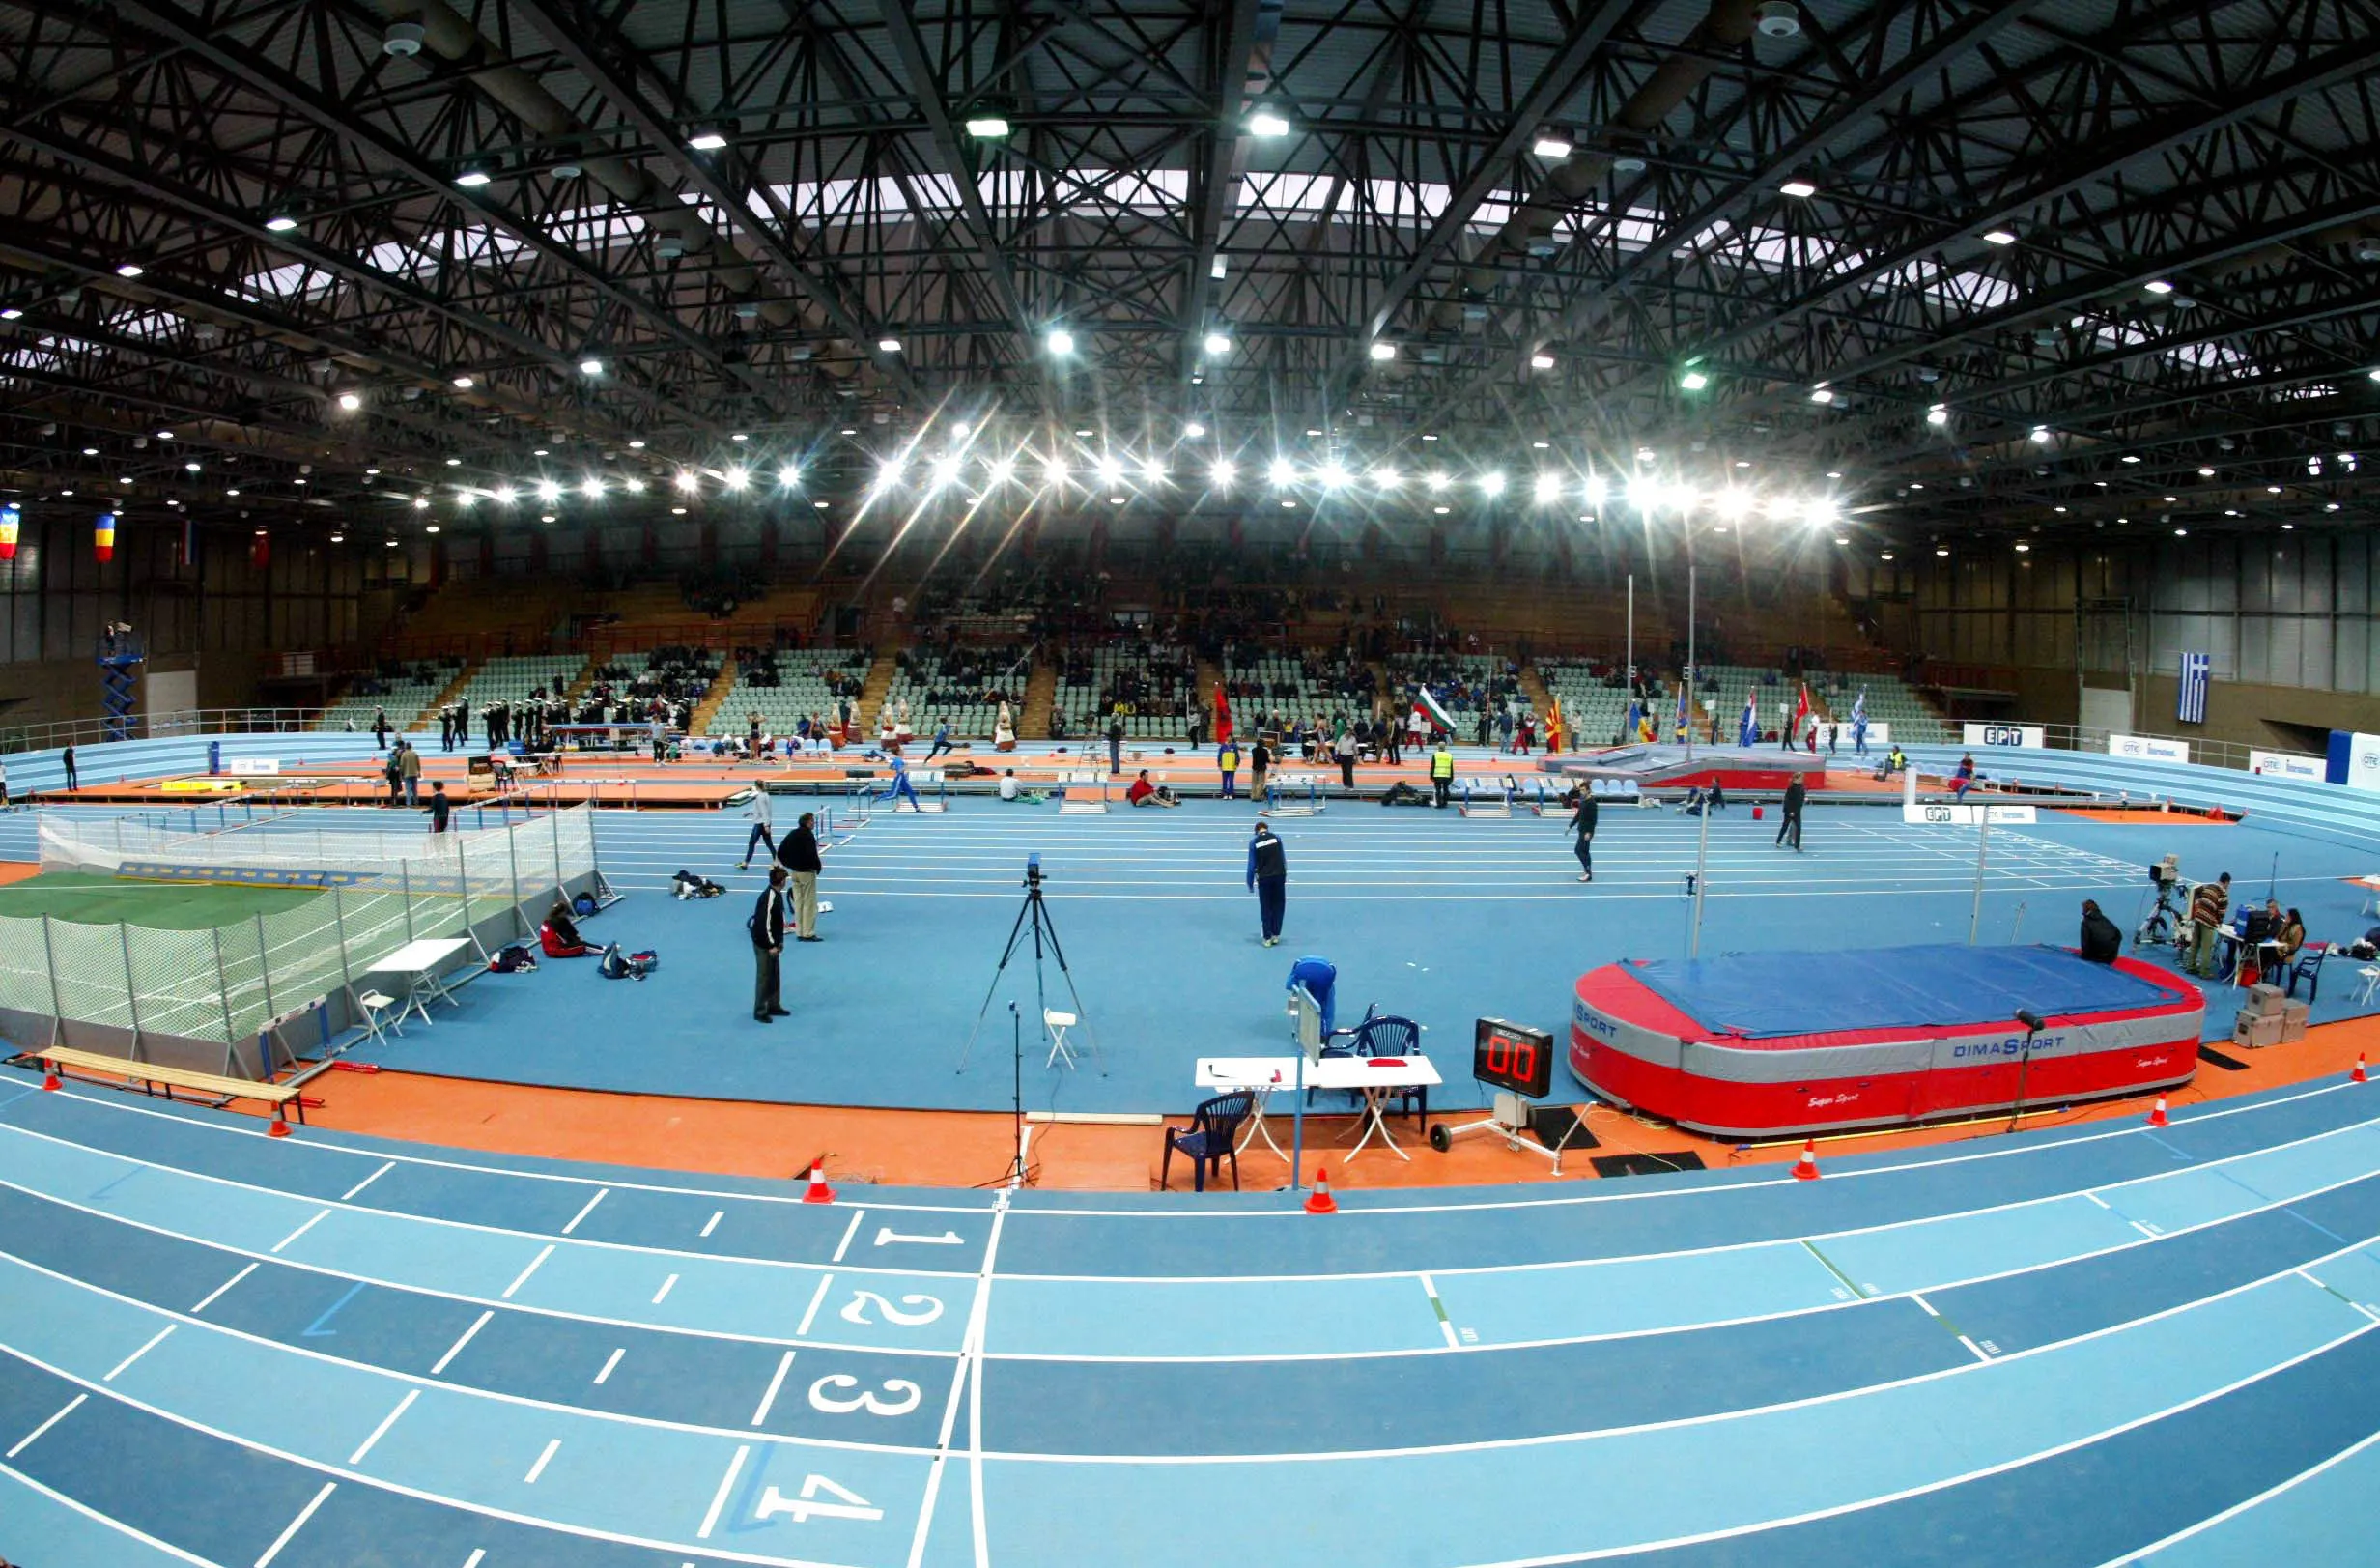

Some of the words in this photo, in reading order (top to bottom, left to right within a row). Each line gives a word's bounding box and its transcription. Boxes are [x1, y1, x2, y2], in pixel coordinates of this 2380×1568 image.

[1576, 1004, 1617, 1038] SPORT
[1487, 1036, 1536, 1082] 00
[1953, 1037, 2065, 1058] DIMASPORT
[873, 1227, 965, 1246] 1
[840, 1290, 944, 1325] 2
[808, 1374, 921, 1415] 3
[754, 1474, 884, 1523] 4
